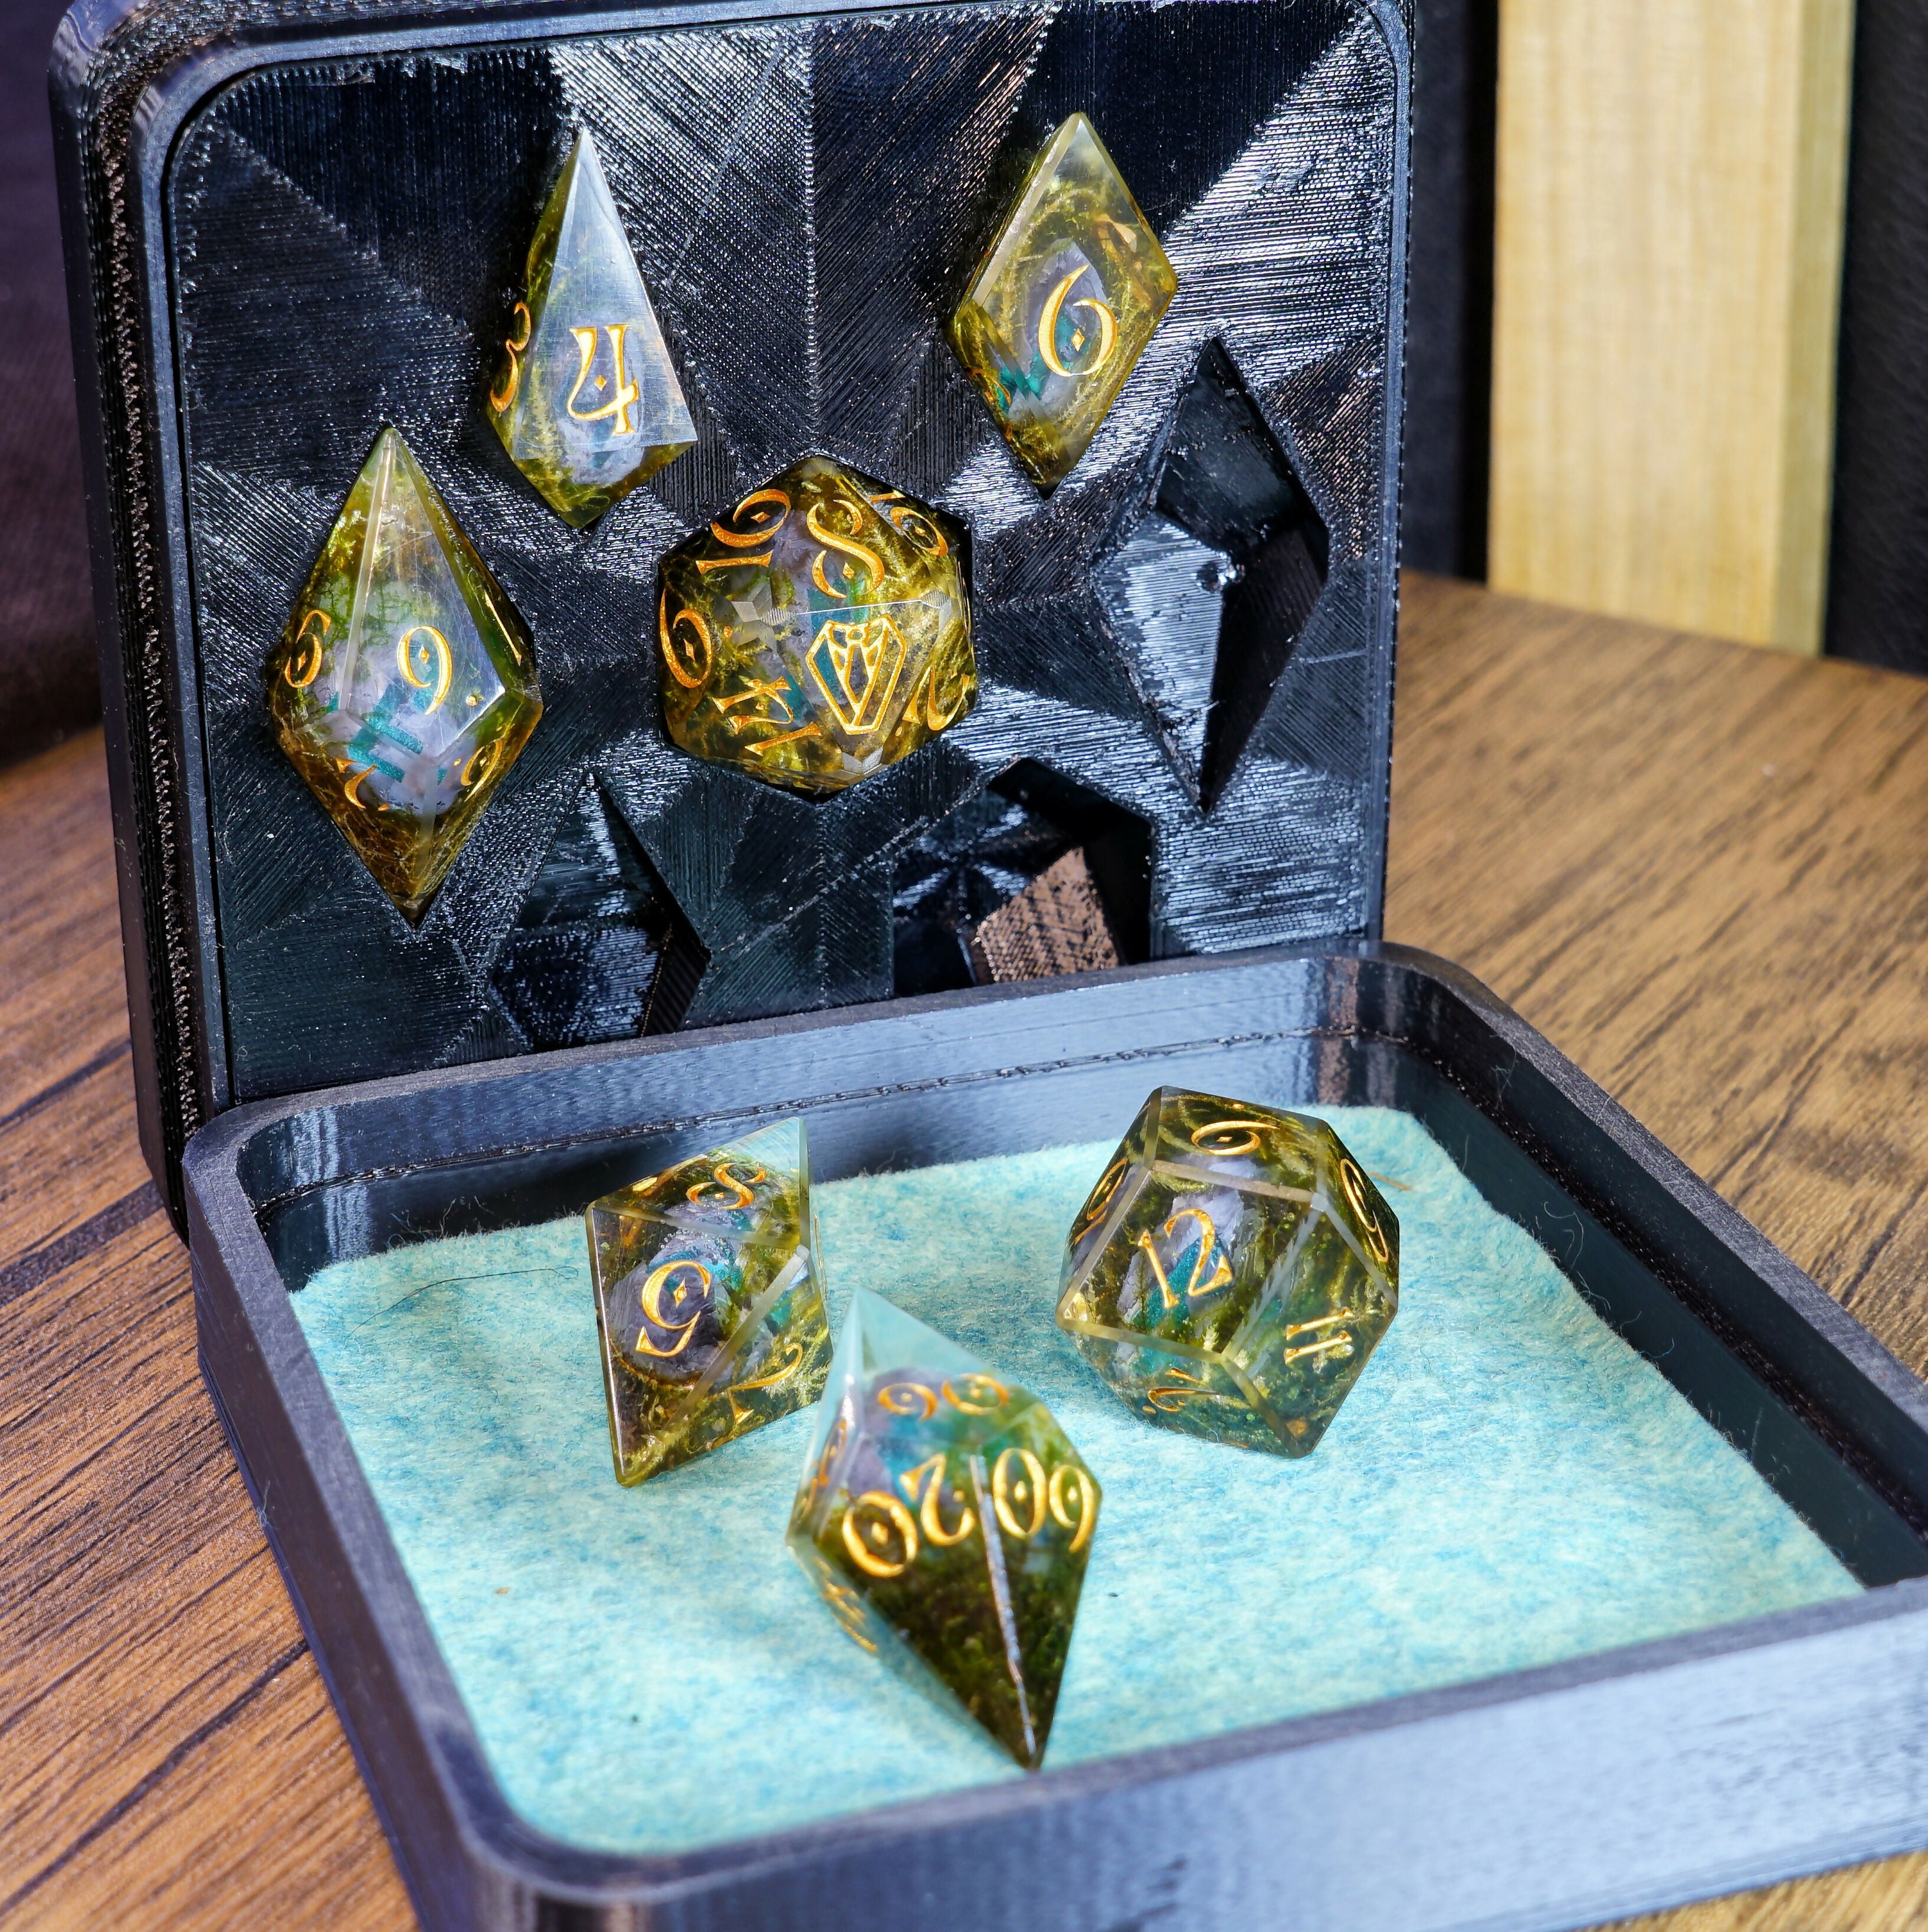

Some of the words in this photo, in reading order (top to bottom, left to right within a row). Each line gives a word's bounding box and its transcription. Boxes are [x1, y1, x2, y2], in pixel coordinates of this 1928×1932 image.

[1038, 264, 1119, 378] 6
[566, 323, 640, 435] 4
[806, 498, 885, 599] 8
[396, 625, 454, 717] 9
[1137, 1207, 1234, 1310] 12
